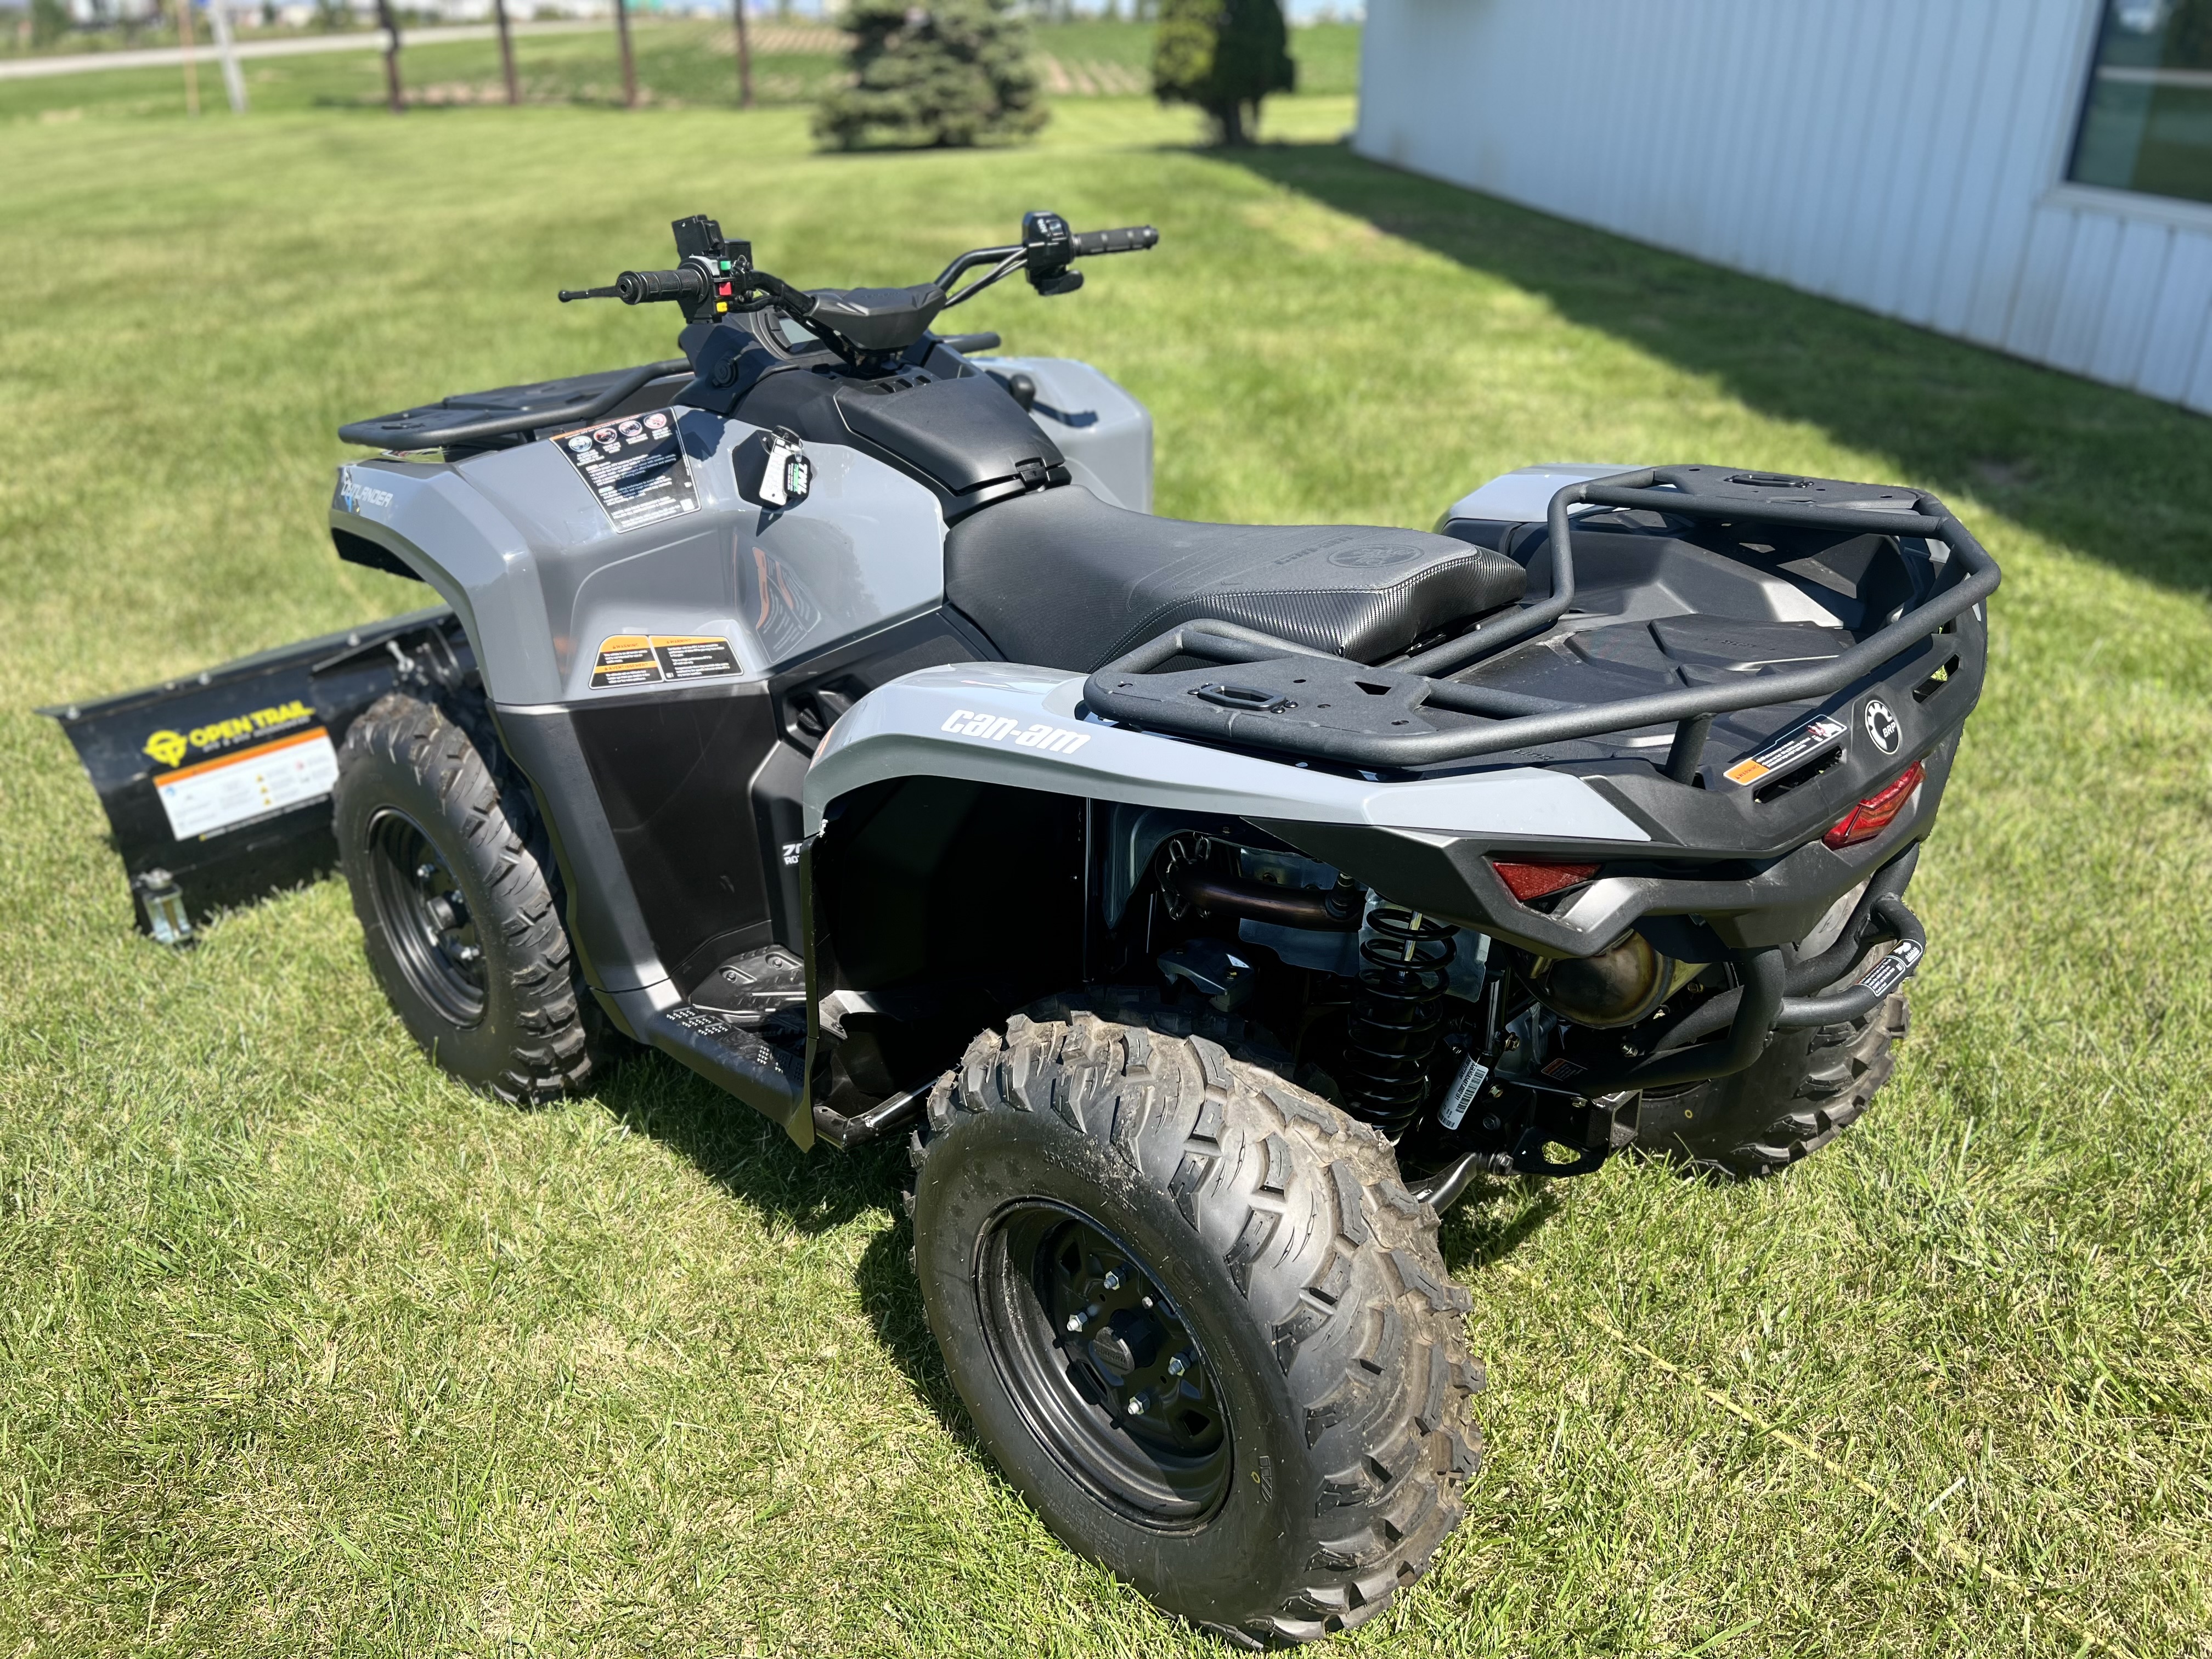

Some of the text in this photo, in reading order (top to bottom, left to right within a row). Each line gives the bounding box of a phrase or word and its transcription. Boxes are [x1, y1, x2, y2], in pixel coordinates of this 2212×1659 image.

[341, 481, 393, 507] OUTLANDER
[189, 716, 253, 747] OPEN
[250, 700, 315, 728] TRAIL
[940, 709, 1091, 754] can-am
[1882, 721, 1896, 738] BRP
[784, 855, 799, 865] RO
[1222, 1334, 1244, 1373] TUBELESS
